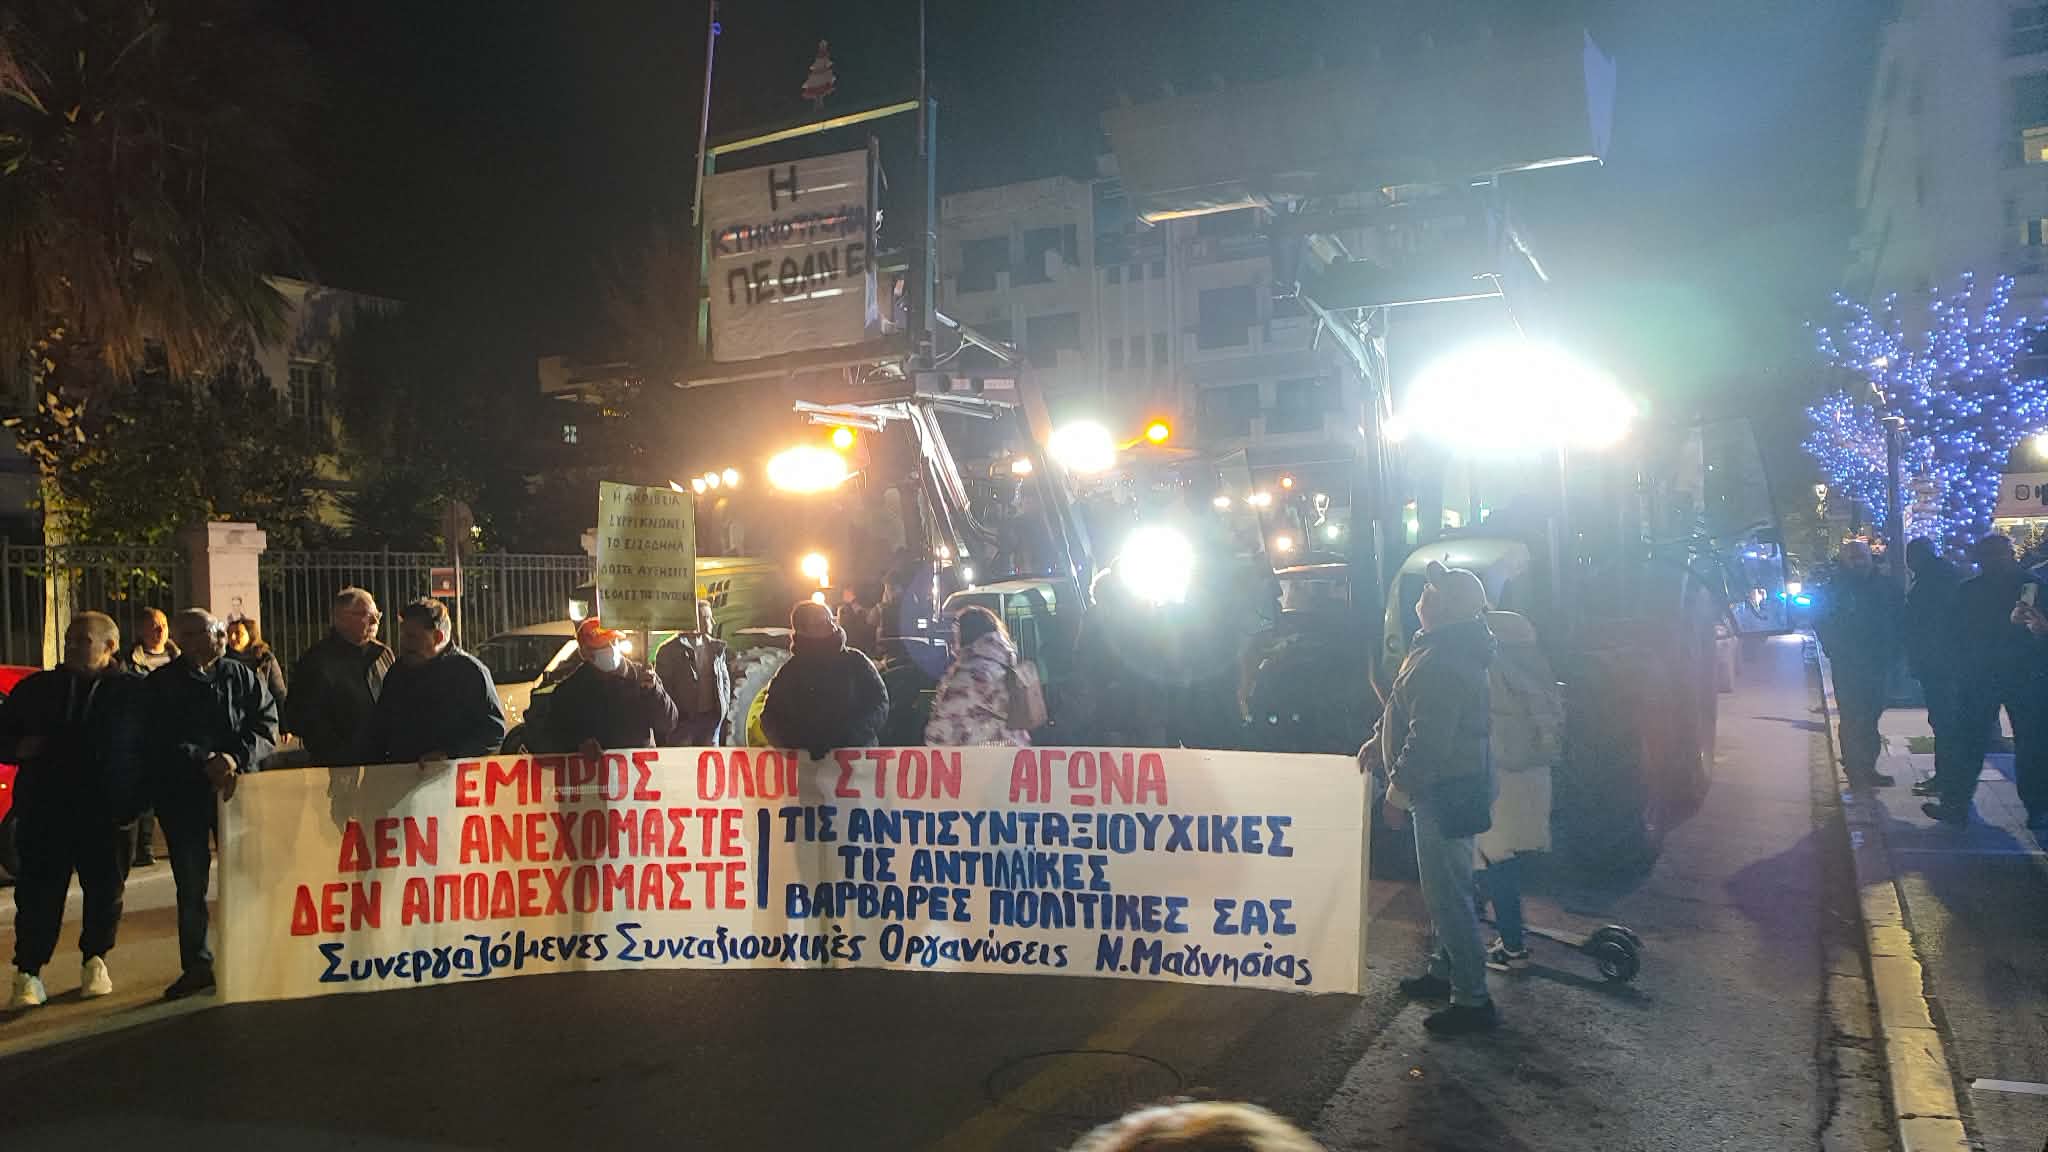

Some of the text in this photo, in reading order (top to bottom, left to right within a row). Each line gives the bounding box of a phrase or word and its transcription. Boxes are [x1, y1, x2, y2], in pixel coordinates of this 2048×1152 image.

[769, 164, 797, 212] Η
[727, 242, 866, 305] ΠΕΘΑΝΕ
[607, 536, 620, 549] ΤΟ
[455, 750, 1168, 808] ΕΜΠΡΟΣ ΟΛΟΙ ΣΤΟΝ ΑΓΩΝΑ
[338, 808, 744, 873] ΔΕΝ ΑΝΕΧΟΜΑΣΤΕ
[779, 806, 1295, 858] ΤΙΣ ΑΝΤΙΣΥΝΤΑΞΙΟΥΧΙΚΕΣ
[838, 846, 896, 882] ΤΙΣ
[290, 861, 747, 936] ΔΕΝ ΑΠΟΔΕΧΟΜΑΣΤΕ
[785, 882, 1297, 936] ΒΑΡΒΑΡΕΣ ΠΟΛΙΤΙΚΕΣ ΣΑΣ
[318, 930, 608, 983] Συνεργαζόμενες
[615, 922, 866, 965] Συνταξιουχικές
[879, 923, 1068, 969] Οργανώσεις
